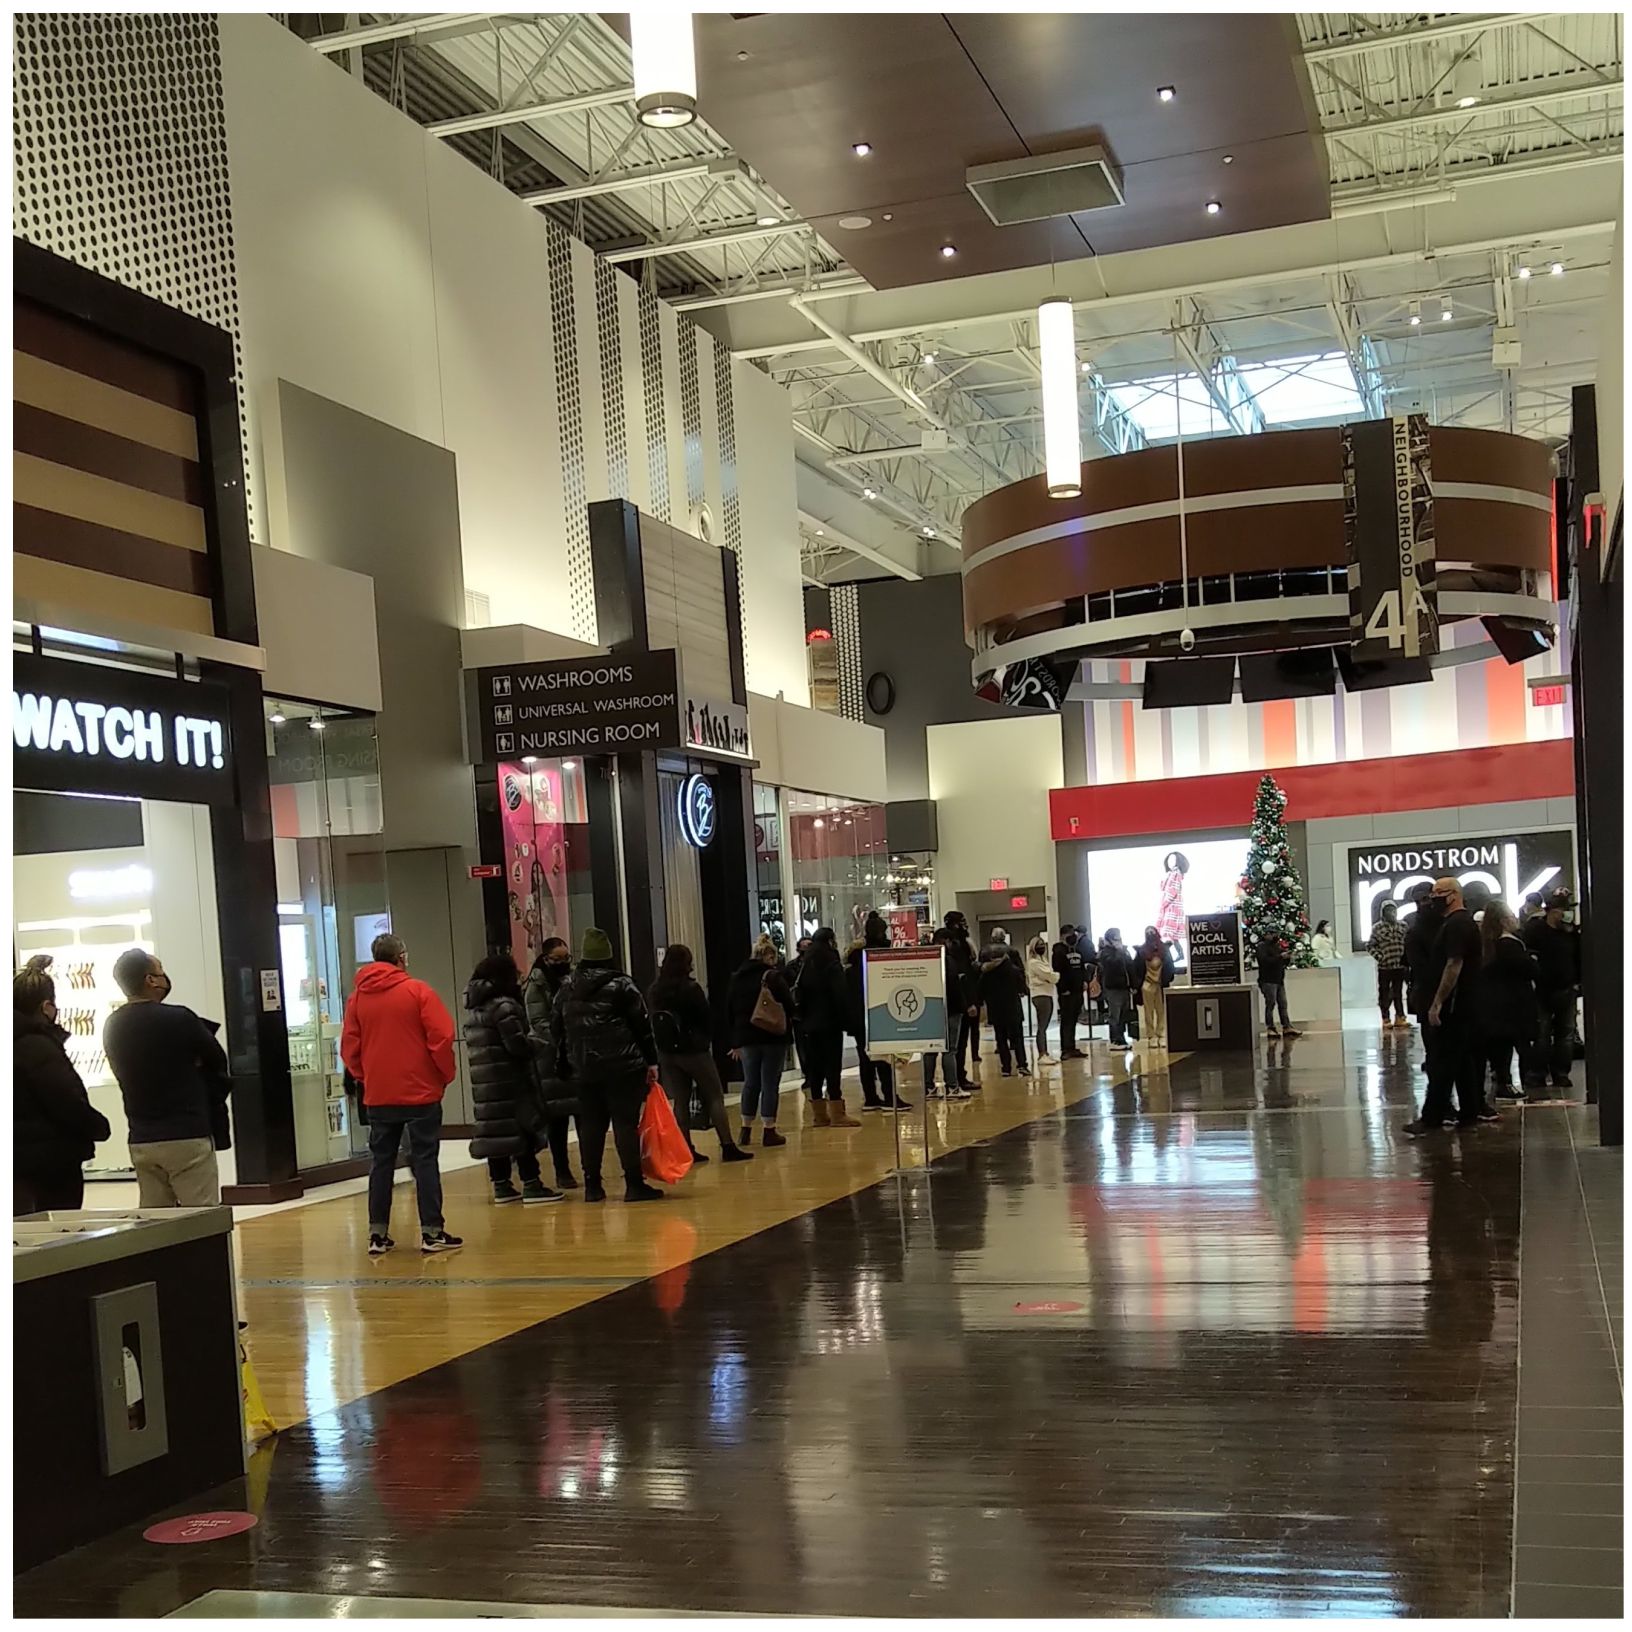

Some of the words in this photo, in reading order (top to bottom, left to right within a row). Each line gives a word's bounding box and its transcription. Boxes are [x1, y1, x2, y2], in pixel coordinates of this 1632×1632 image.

[1394, 422, 1413, 578] NEIGHBOURHOOD
[518, 666, 633, 692] WASHROOMS
[518, 702, 588, 720] UNIVERSAL
[593, 693, 675, 712] WASHROOM
[1535, 687, 1563, 706] EXIT
[13, 691, 164, 763] WATCH
[175, 715, 225, 769] IT!
[521, 727, 599, 749] NURSING
[605, 722, 660, 743] ROOM
[1358, 845, 1499, 874] NORDSTROM
[1190, 922, 1208, 932] WE
[1191, 933, 1227, 943] LOCAL
[1191, 944, 1234, 956] ARTISTS
